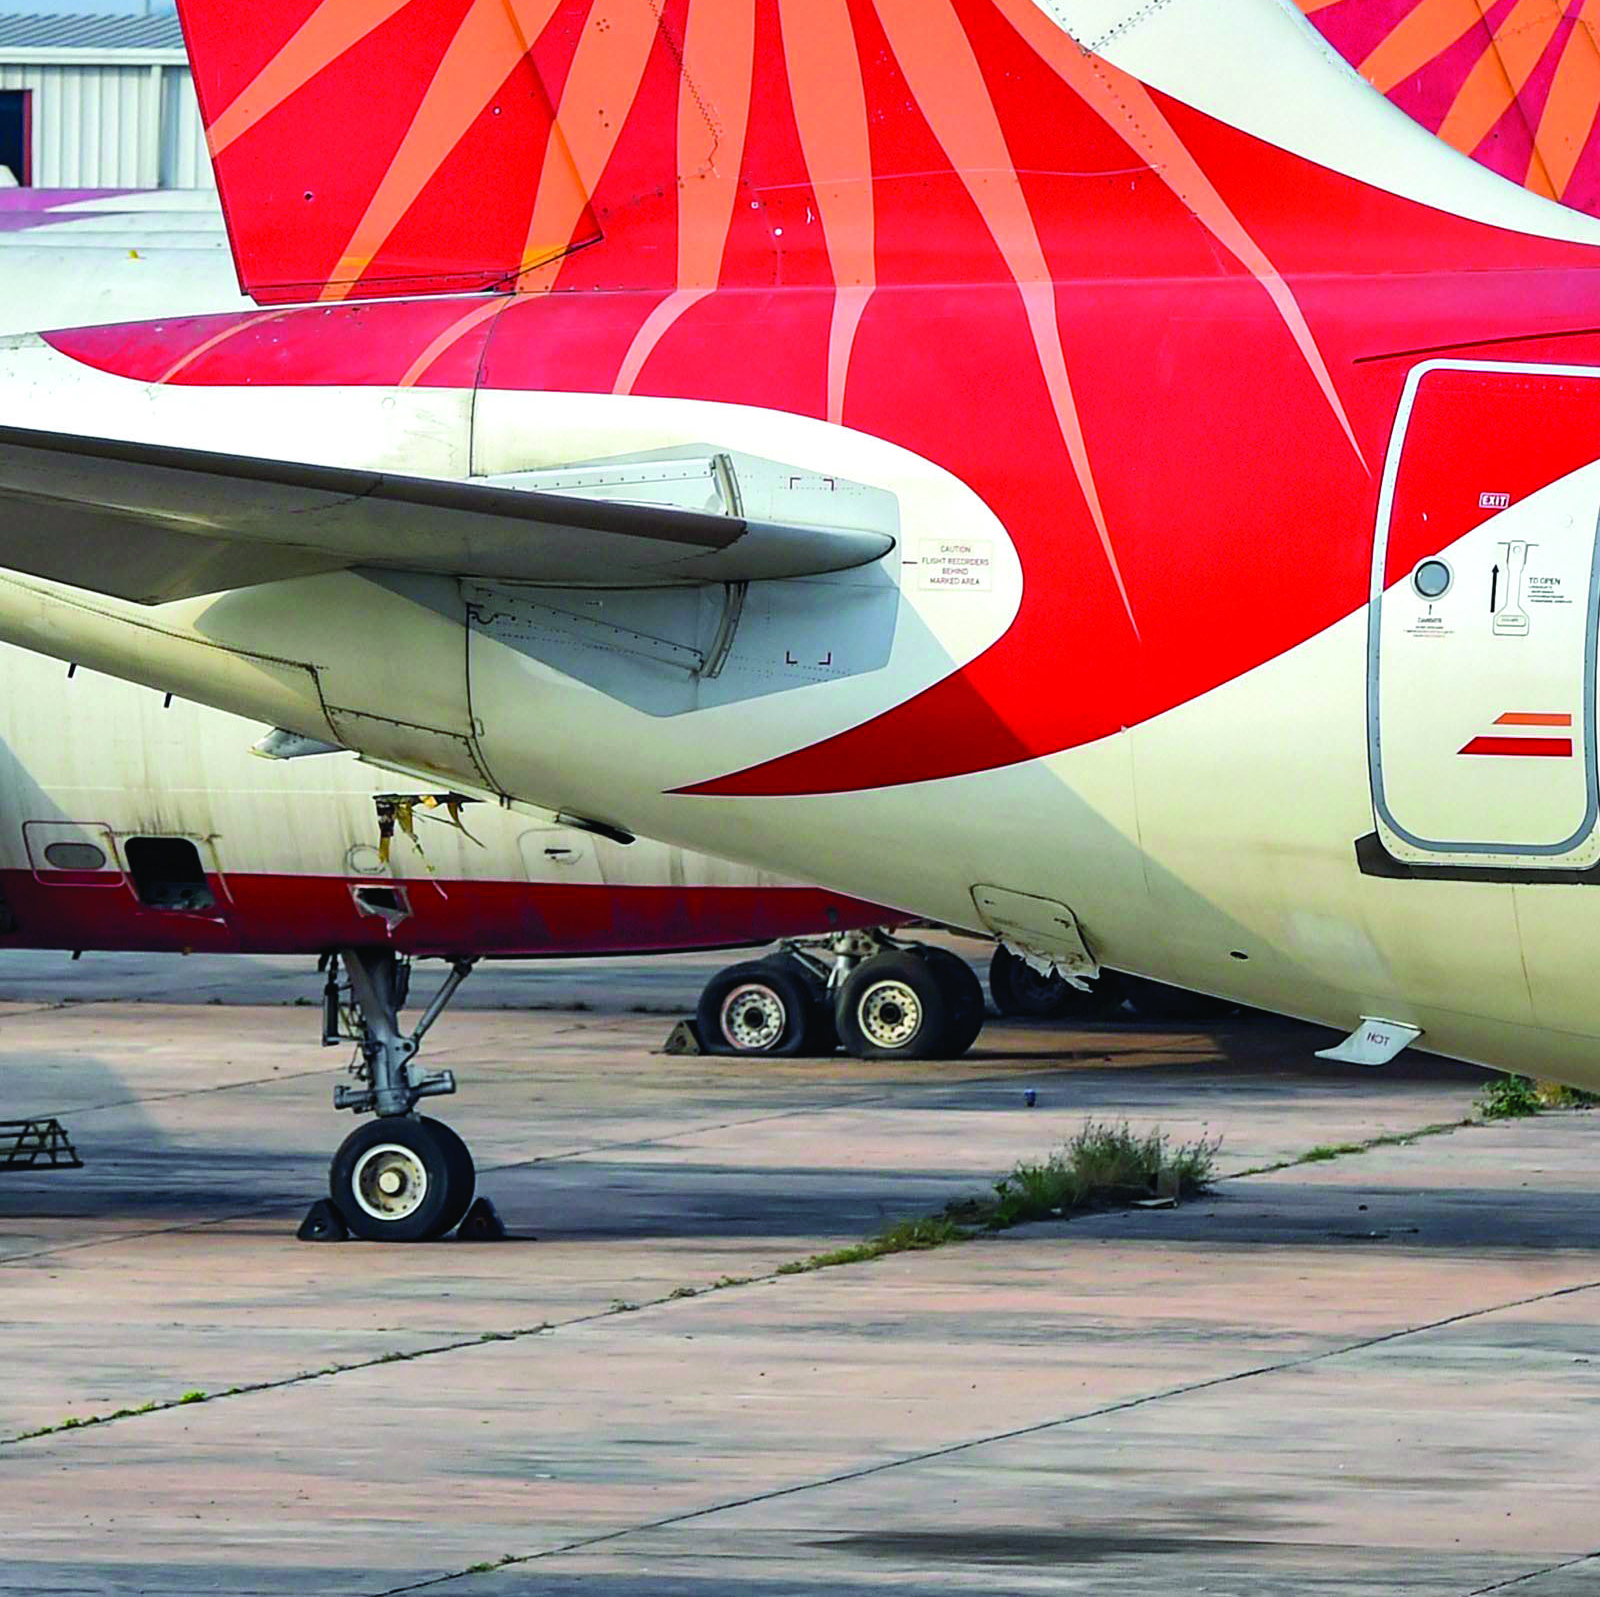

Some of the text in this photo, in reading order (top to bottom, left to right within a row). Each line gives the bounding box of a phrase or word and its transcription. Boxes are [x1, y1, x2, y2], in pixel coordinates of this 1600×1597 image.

[1482, 494, 1508, 507] EXIT
[940, 545, 971, 553] CAUTION
[1366, 1031, 1390, 1047] HOT
